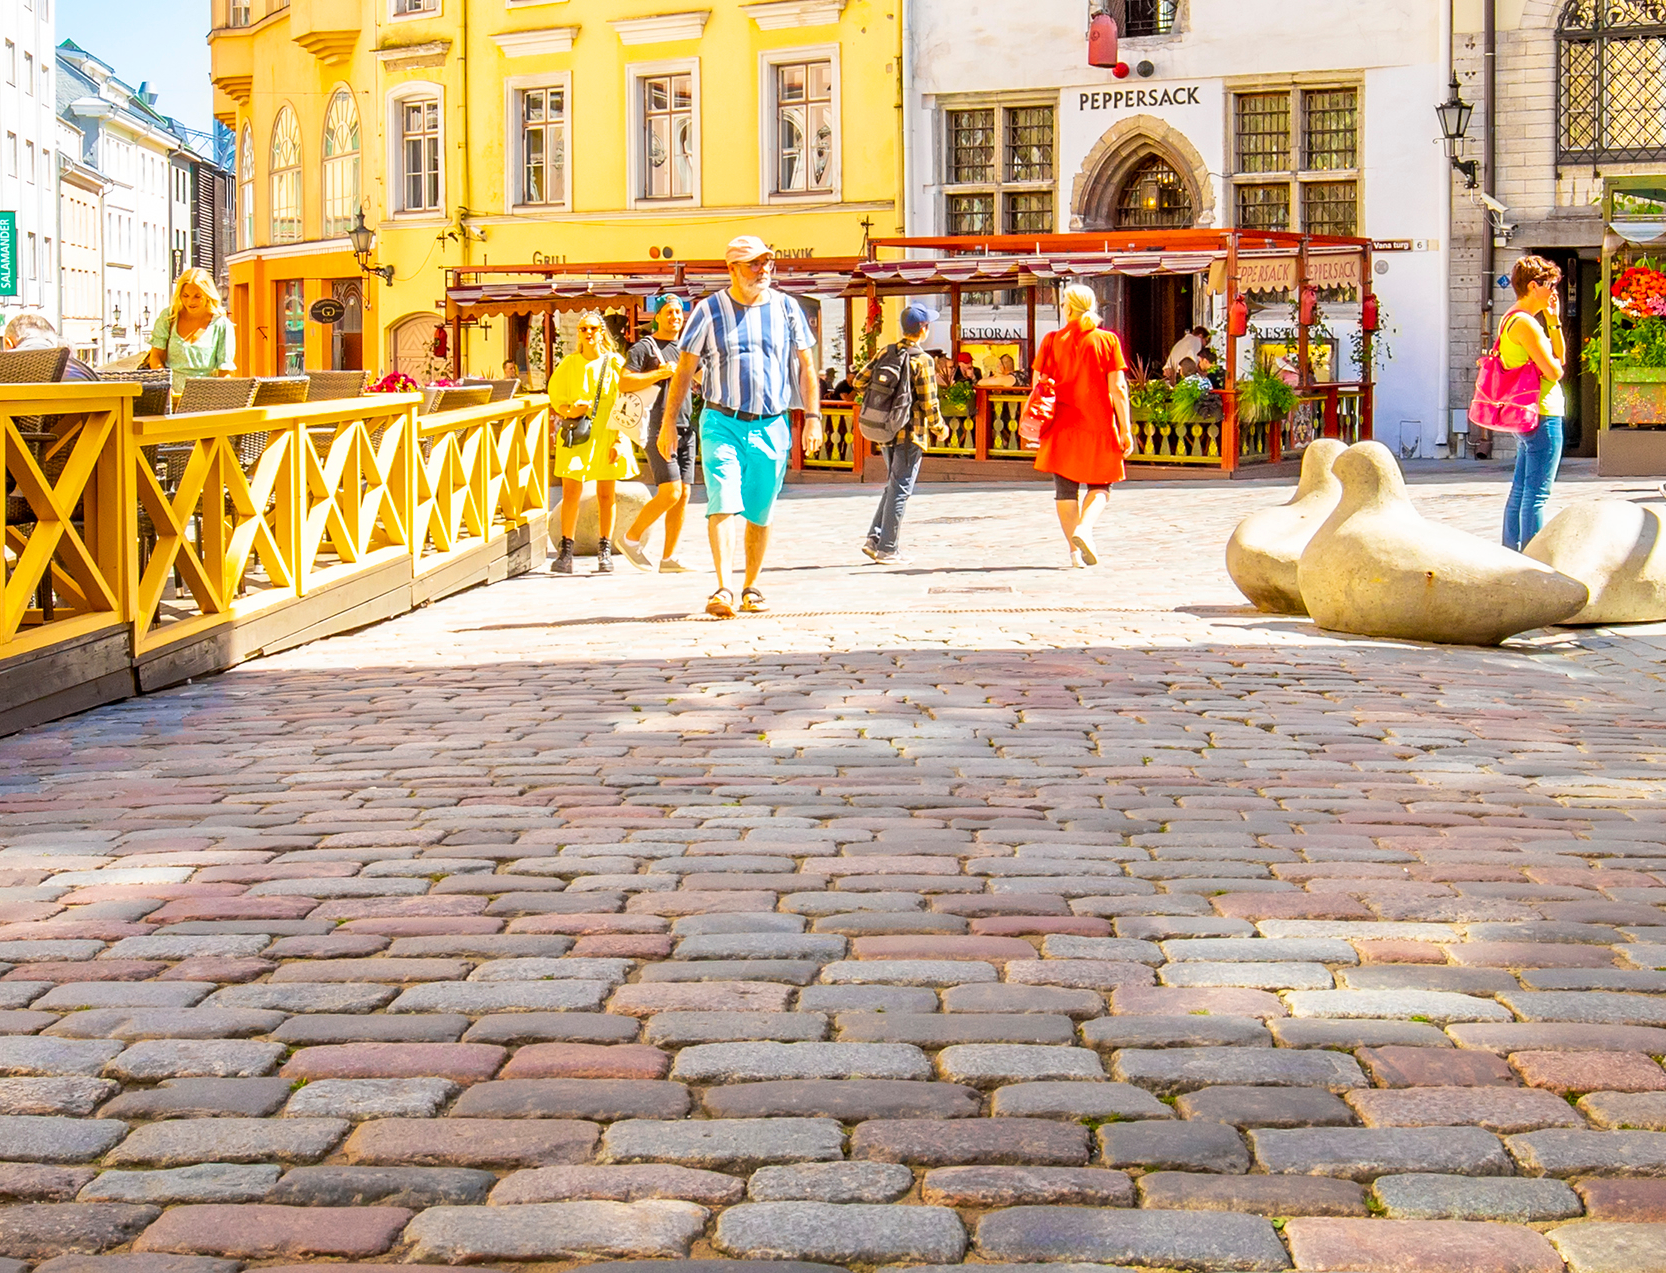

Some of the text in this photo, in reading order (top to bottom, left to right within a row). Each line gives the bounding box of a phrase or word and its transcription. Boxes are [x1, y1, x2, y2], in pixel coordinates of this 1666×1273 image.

[1079, 86, 1200, 111] PEPPERSACK
[1373, 241, 1409, 250] Vana turg
[1417, 241, 1423, 249] 6
[0, 218, 12, 289] SALAMANDER
[962, 327, 1022, 339] ESTORAN
